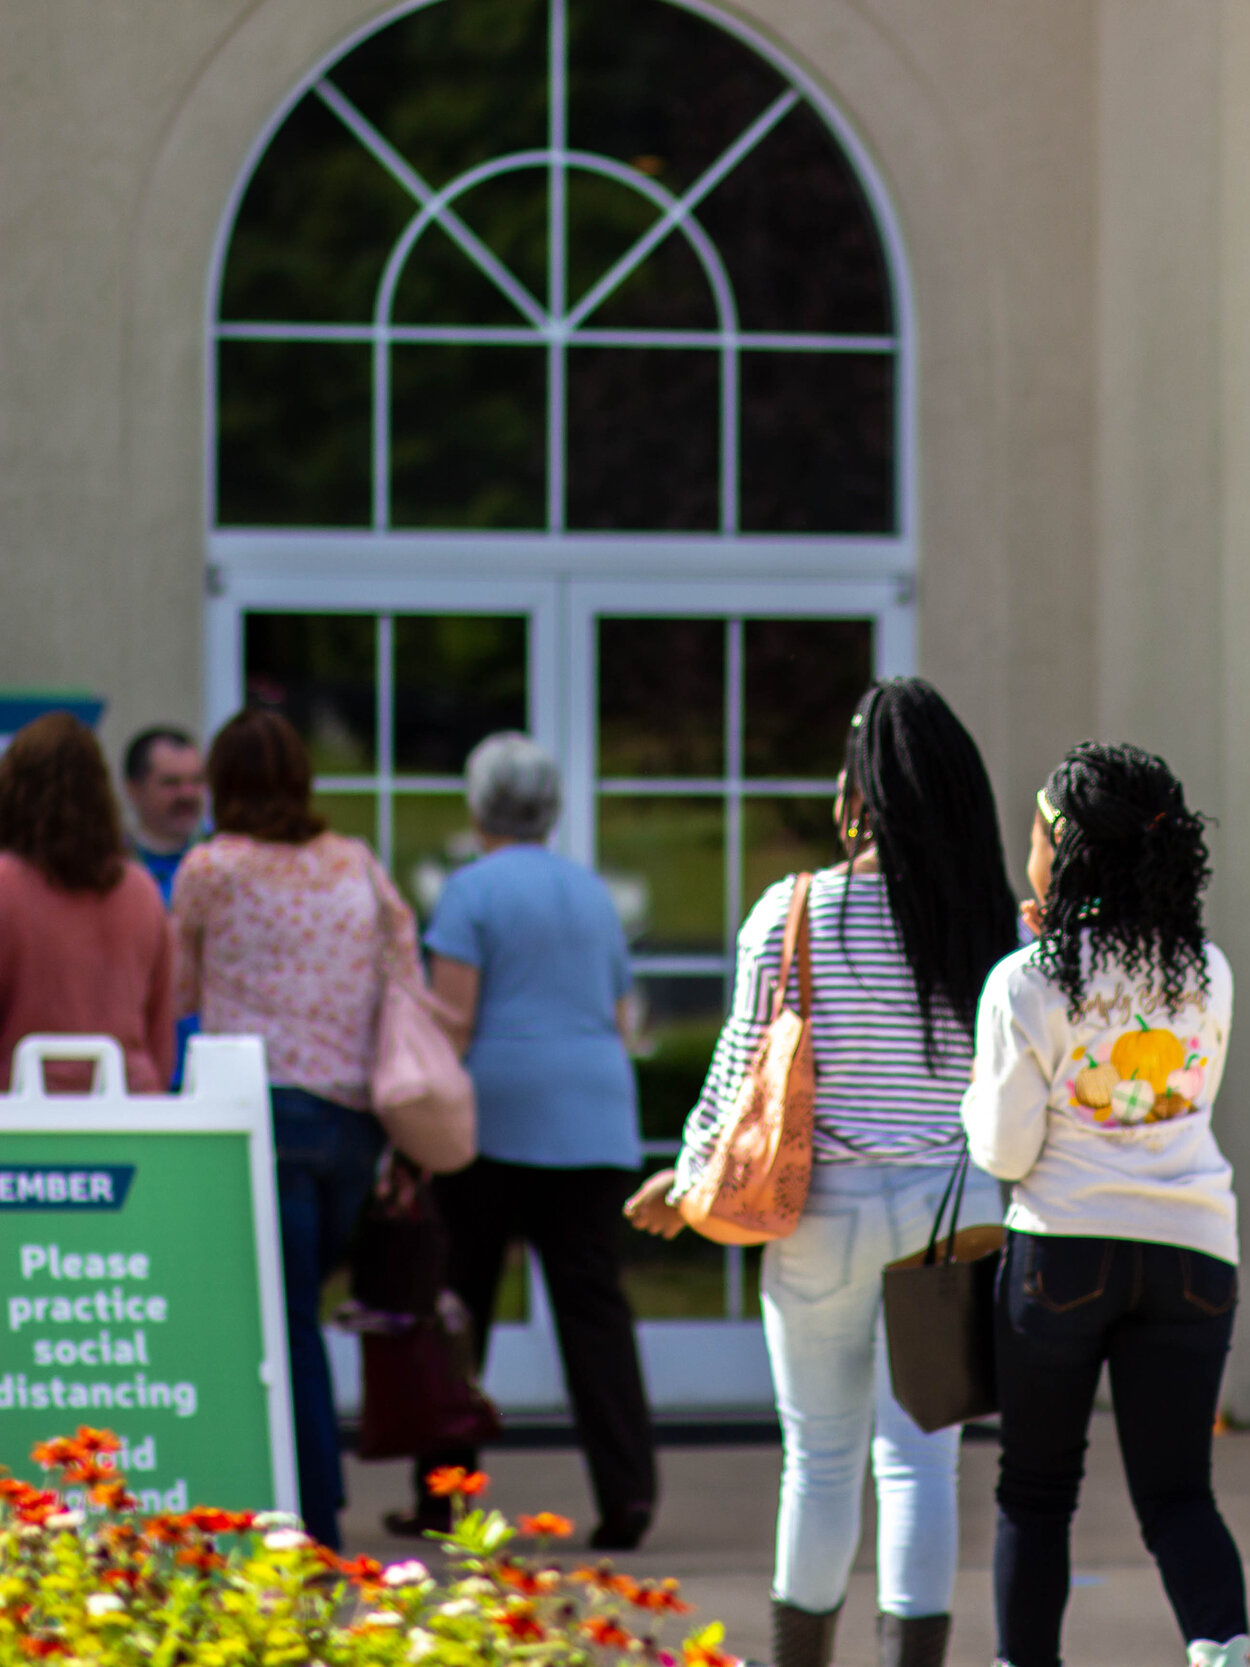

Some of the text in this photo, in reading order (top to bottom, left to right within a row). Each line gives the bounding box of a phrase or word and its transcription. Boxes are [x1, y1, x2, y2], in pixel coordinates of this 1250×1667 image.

[0, 1171, 113, 1201] EMBER
[21, 1244, 149, 1279] Please
[9, 1286, 167, 1331] practice
[34, 1330, 148, 1365] social
